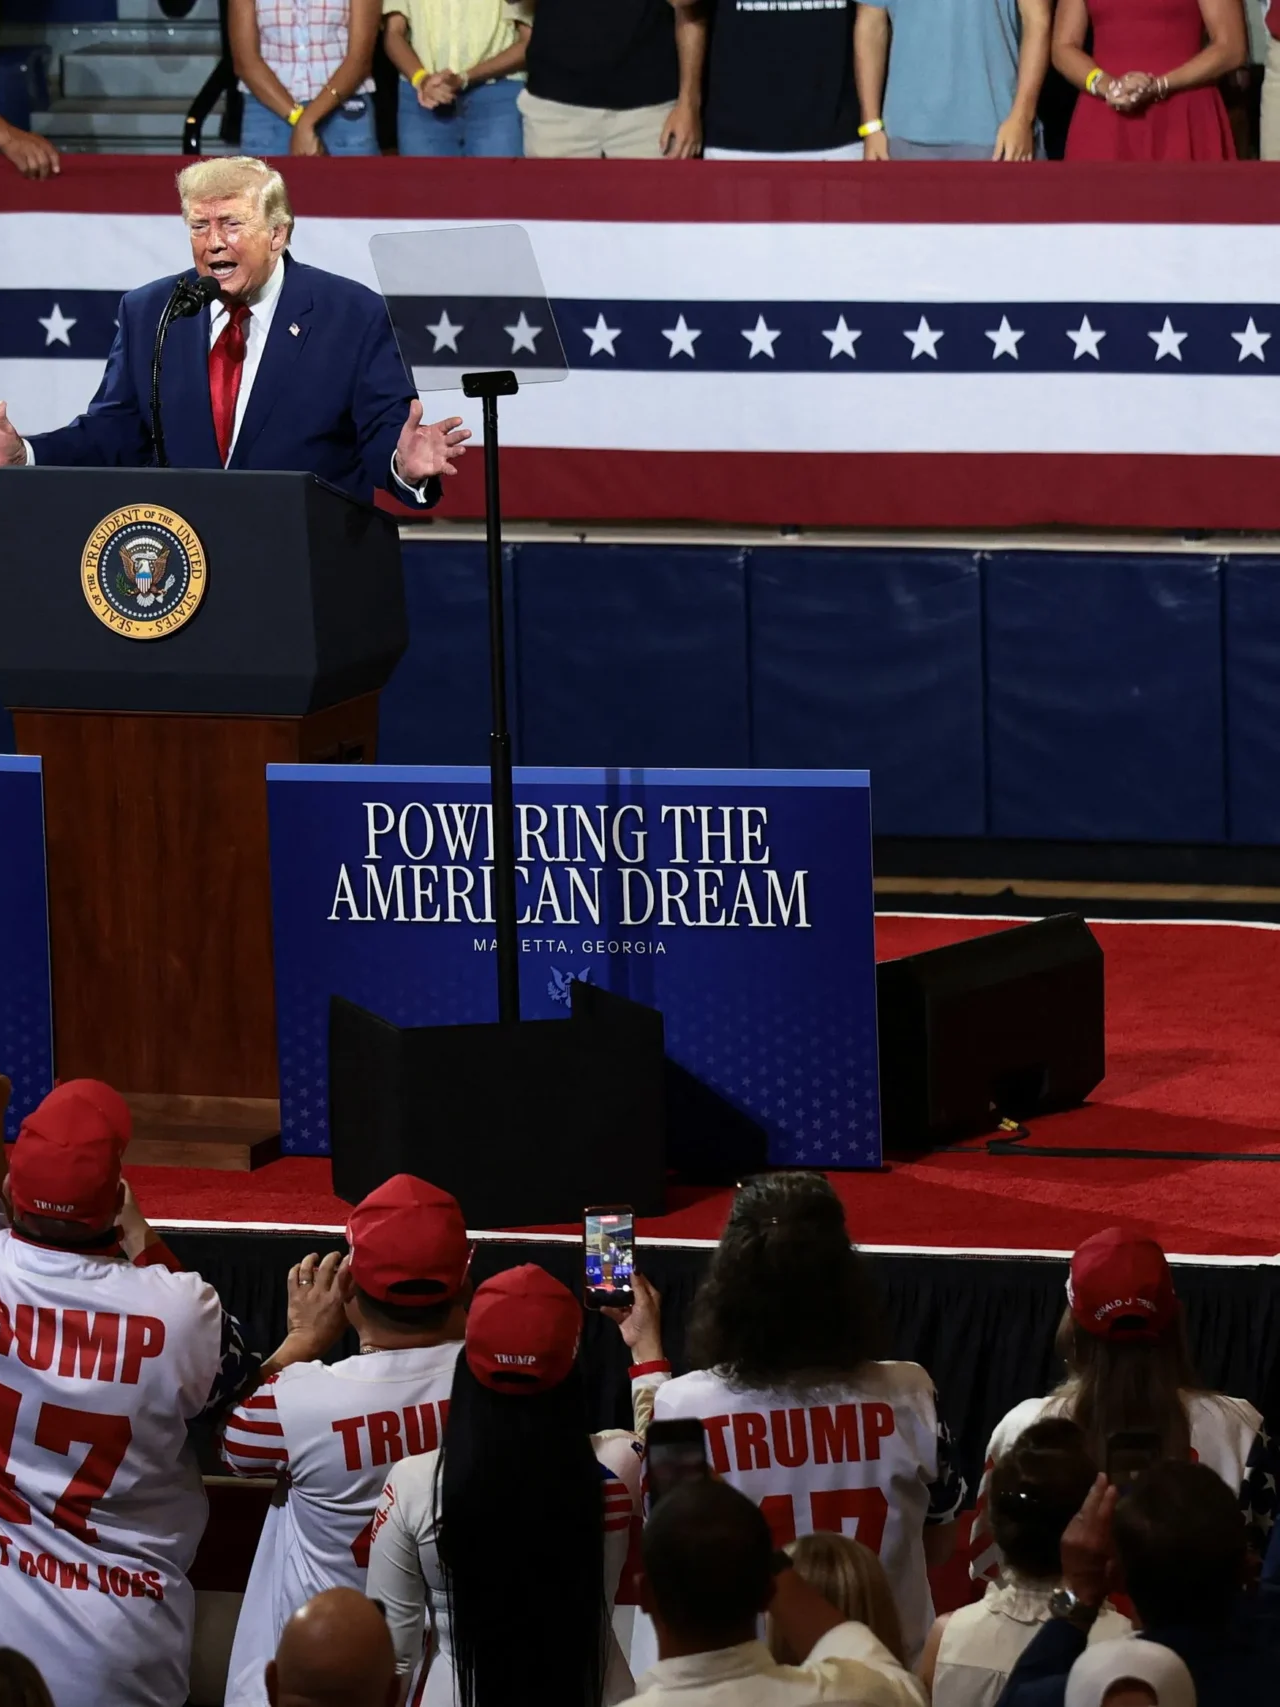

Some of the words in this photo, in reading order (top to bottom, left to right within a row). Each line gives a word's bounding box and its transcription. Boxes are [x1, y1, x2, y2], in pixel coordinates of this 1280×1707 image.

[143, 510, 157, 519] OF
[158, 512, 174, 527] THE
[85, 508, 141, 569] PRESIDENT
[176, 525, 203, 580] UNITED
[86, 573, 97, 592] THE
[92, 594, 103, 607] OF
[155, 591, 198, 633] STATES
[101, 604, 133, 633] SEAL
[661, 804, 771, 865] THE
[618, 866, 813, 929] DREAM
[472, 937, 575, 955] MAETTA,
[581, 938, 668, 956] GEORGIA
[33, 1199, 75, 1213] TRUMP
[494, 1353, 536, 1365] TRUMP
[331, 1398, 452, 1472] TRU
[701, 1402, 895, 1475] TRUMP
